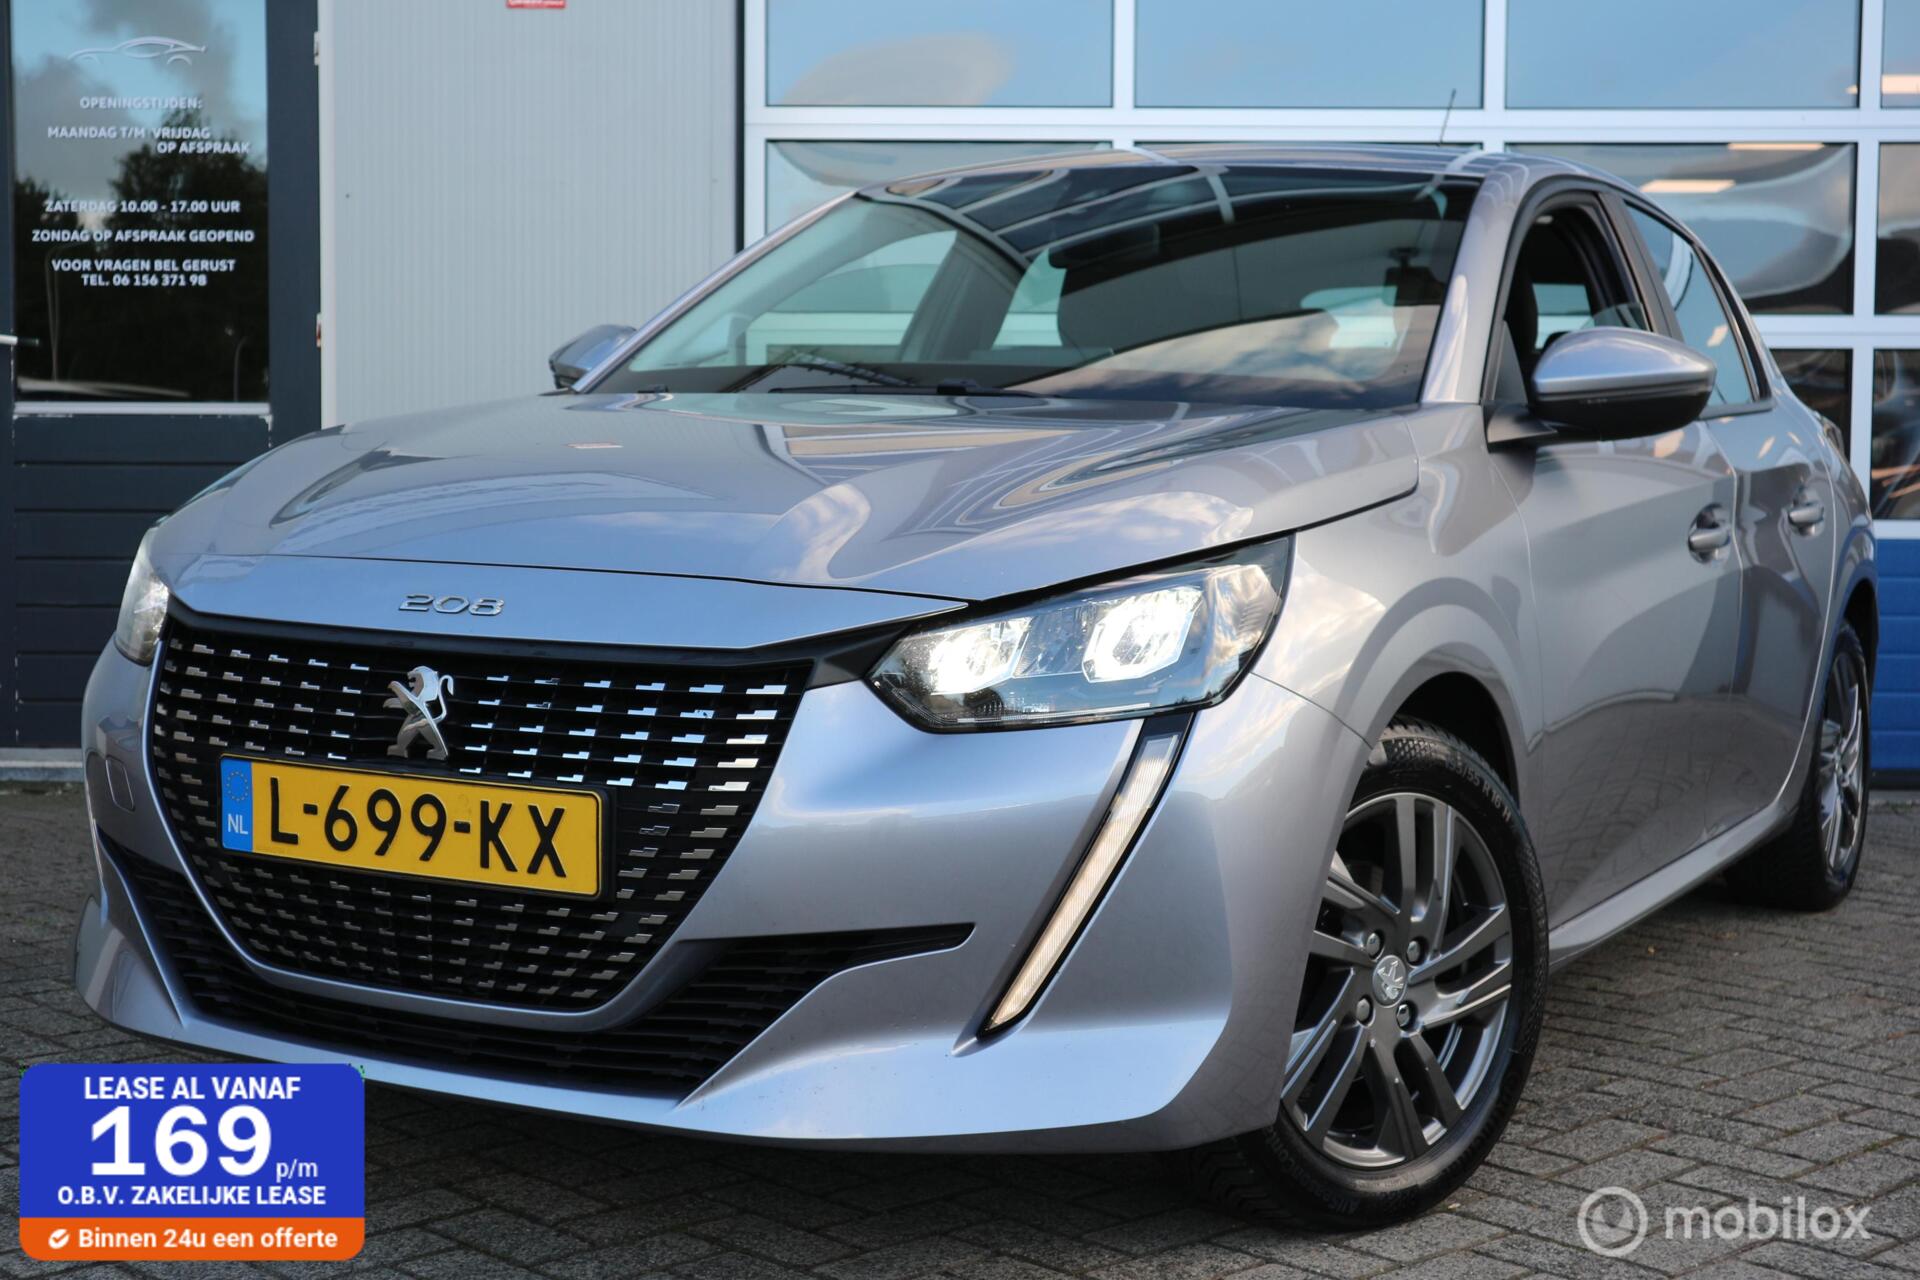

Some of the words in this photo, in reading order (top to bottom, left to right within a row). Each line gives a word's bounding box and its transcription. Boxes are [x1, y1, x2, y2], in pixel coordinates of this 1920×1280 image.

[80, 97, 202, 109] OPENINGSTIJDEN:
[48, 127, 117, 138] MAANDAG
[120, 127, 145, 138] T/M
[152, 126, 211, 139] VRIJDAG
[157, 142, 176, 154] OP
[179, 141, 250, 154] AFSPRAAK
[44, 200, 117, 213] ZATERDAG
[120, 201, 157, 212] 10.00
[171, 201, 208, 212] 17.00
[211, 200, 240, 212] UUR
[32, 230, 90, 242] ZONDAG
[93, 230, 111, 242] OP
[115, 230, 187, 242] AFSPRAAK
[189, 230, 254, 242] GEOPEND
[51, 259, 91, 271] VOOR
[94, 259, 150, 271] VRAGEN
[154, 259, 179, 271] BEL
[182, 259, 235, 271] GERUST
[81, 275, 109, 286] TEL.
[113, 274, 129, 286] 06
[133, 274, 158, 286] 156
[161, 274, 186, 286] 371
[189, 274, 207, 286] 98
[398, 593, 504, 616] 208
[227, 812, 248, 835] NL
[269, 776, 567, 878] L-699-KX
